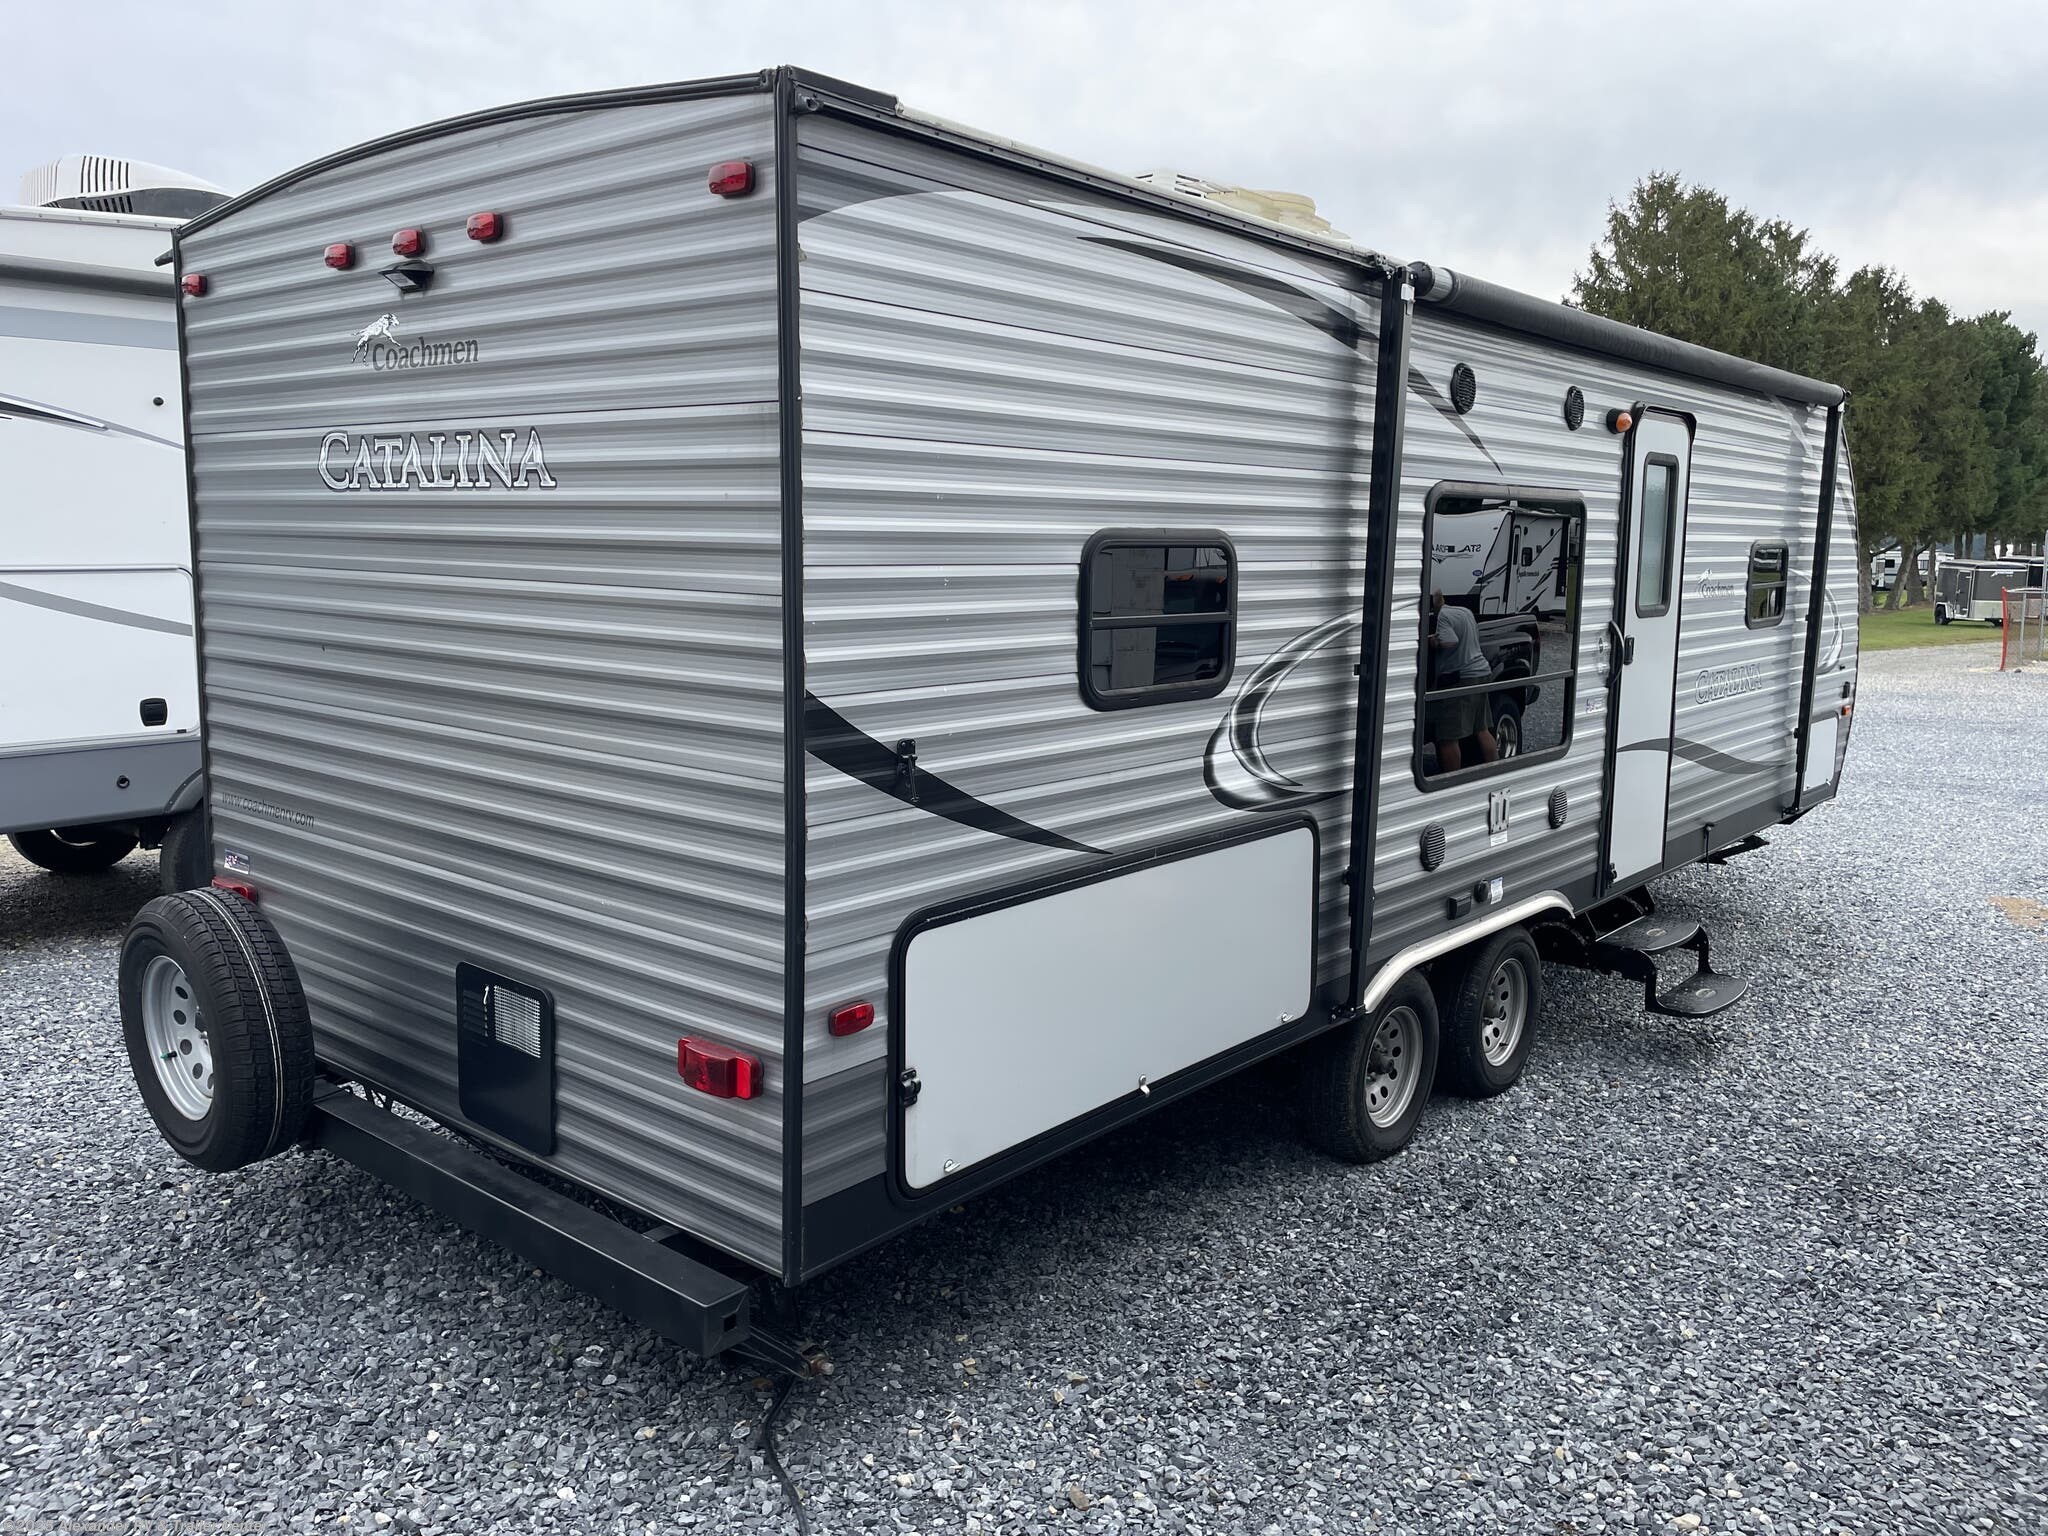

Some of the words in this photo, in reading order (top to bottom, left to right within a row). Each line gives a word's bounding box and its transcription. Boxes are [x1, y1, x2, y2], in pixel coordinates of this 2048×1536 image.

[372, 336, 479, 371] Coachmen
[318, 426, 557, 491] CATALINA
[1701, 581, 1735, 598] Coachmen
[1695, 662, 1762, 704] CATALINA
